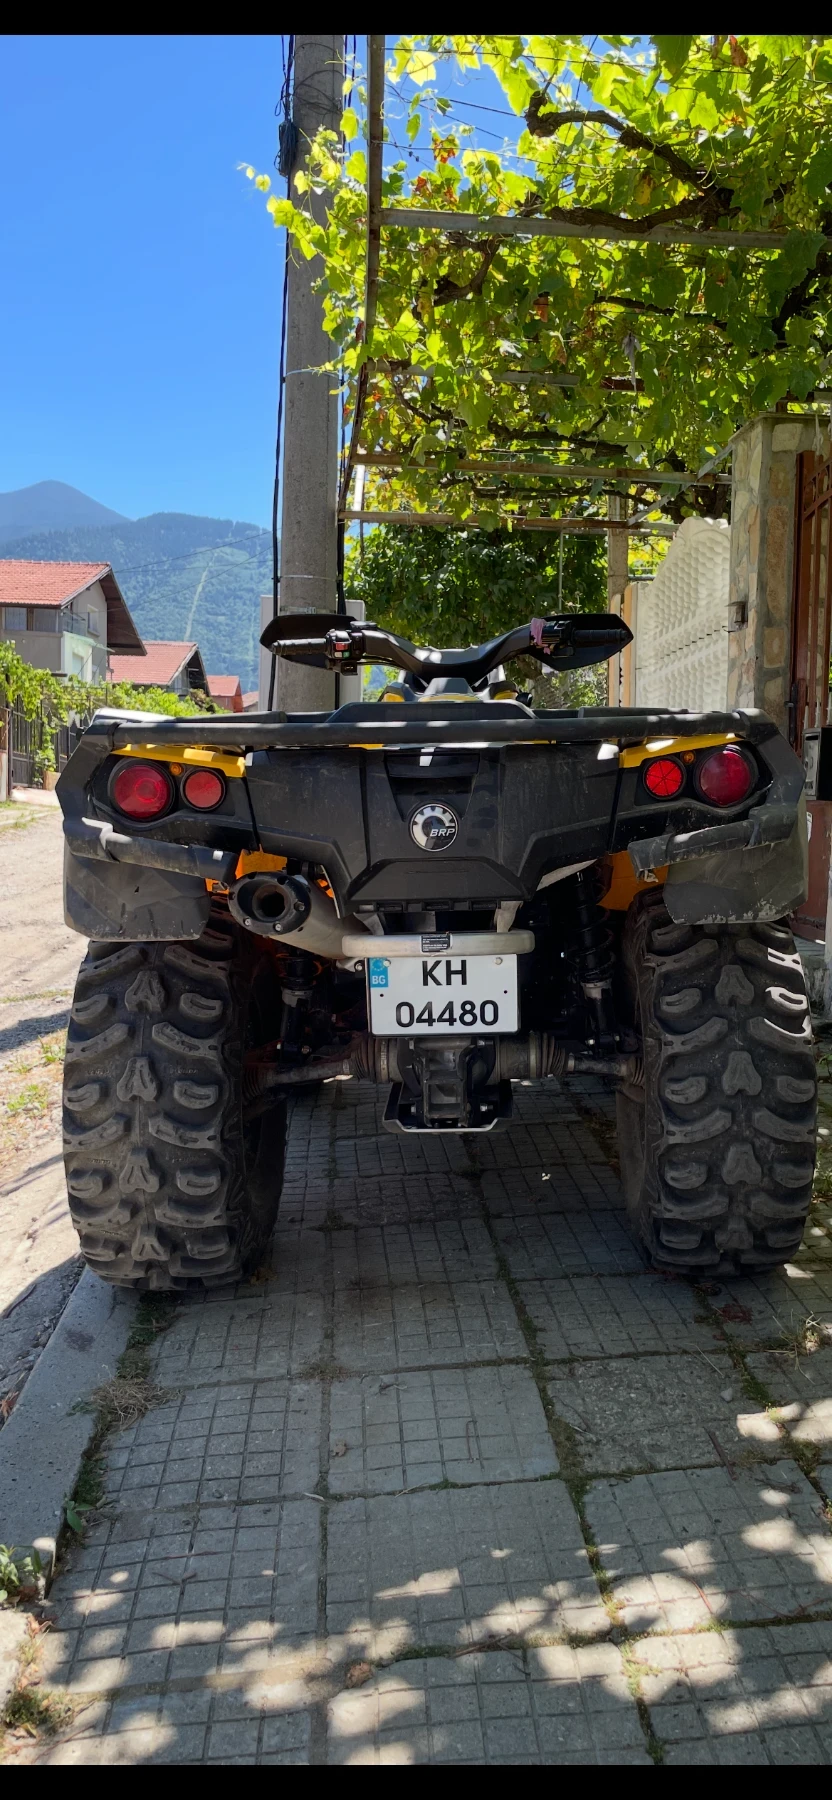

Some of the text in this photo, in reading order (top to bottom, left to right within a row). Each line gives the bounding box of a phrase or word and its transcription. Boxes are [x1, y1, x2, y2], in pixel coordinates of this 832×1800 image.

[430, 828, 455, 837] BRP
[372, 975, 386, 985] BG
[422, 959, 468, 987] KH
[395, 1000, 499, 1028] 04480
